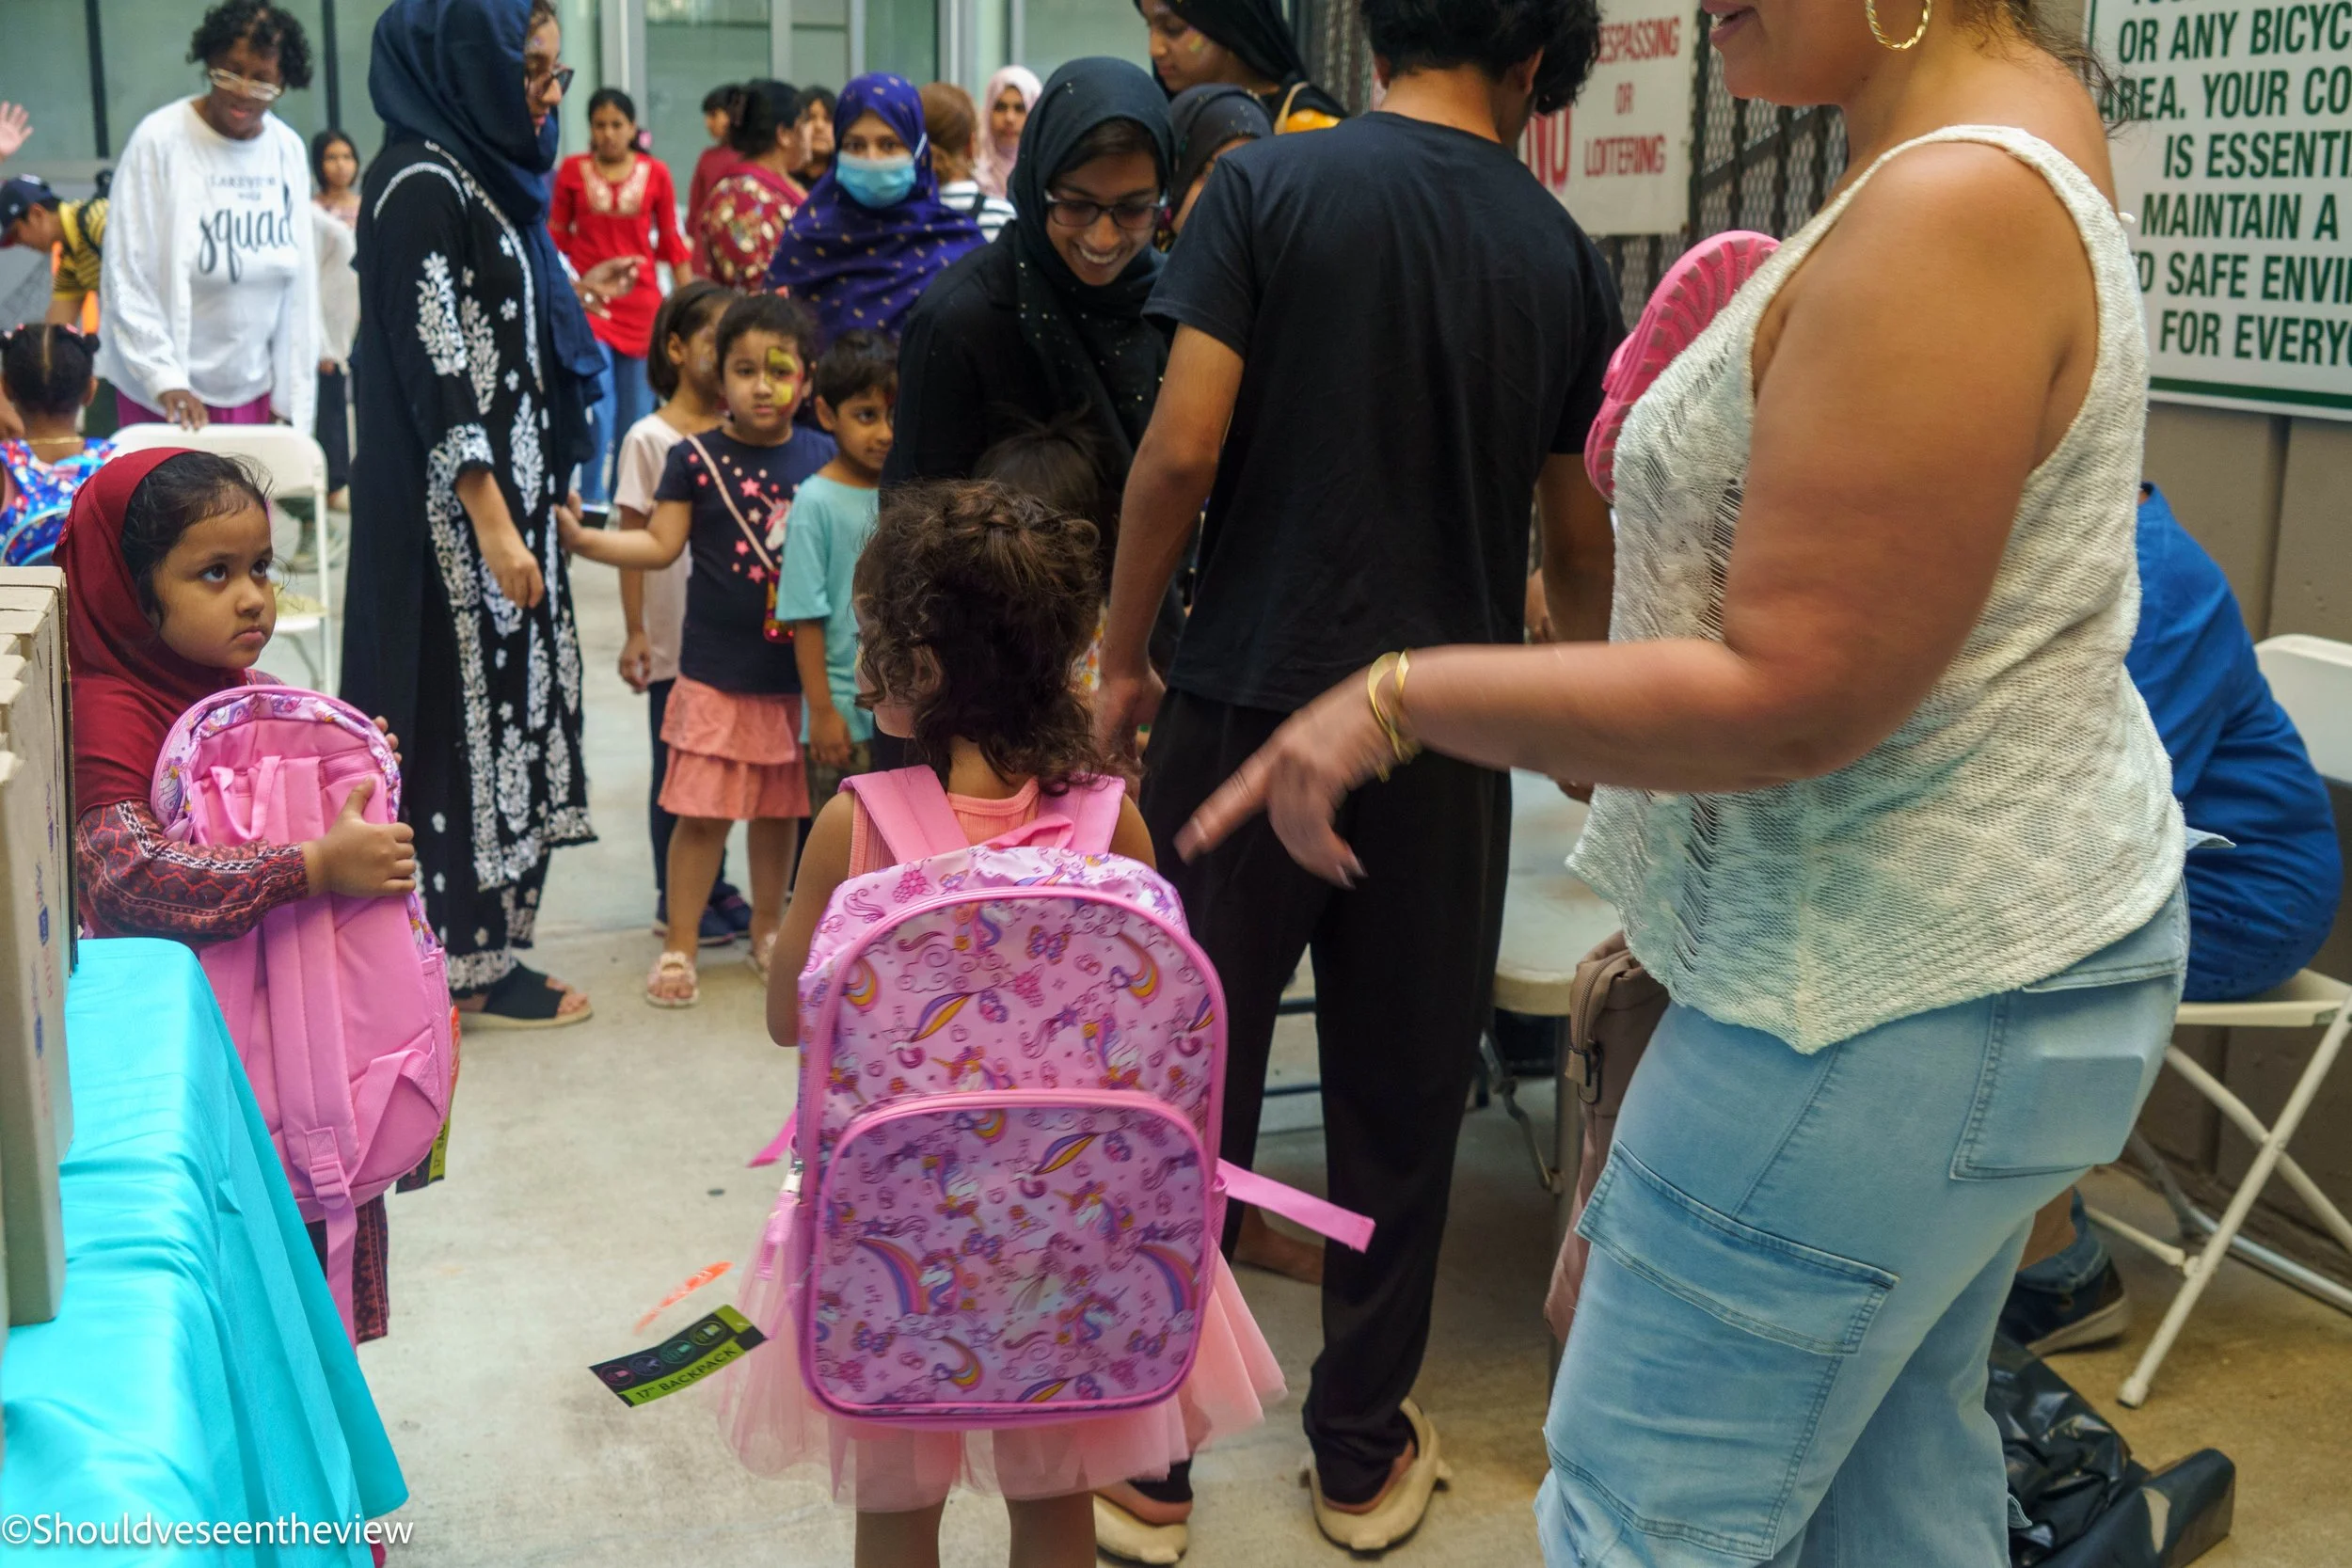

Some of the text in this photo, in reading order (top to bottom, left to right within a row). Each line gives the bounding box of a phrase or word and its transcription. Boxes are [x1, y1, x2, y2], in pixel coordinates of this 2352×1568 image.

[1597, 15, 1680, 64] ESPASSING
[2119, 1, 2352, 63] OR ANY BICYC
[1615, 81, 1634, 115] OR
[2099, 65, 2352, 120] AREA. YOUR CO
[1526, 103, 1573, 194] NO
[1584, 134, 1665, 177] LOITERING
[2164, 134, 2195, 179] IS
[198, 182, 298, 285] squad
[2140, 193, 2339, 242] MAINTAIN A
[2131, 250, 2154, 293] D
[2167, 251, 2249, 299] SAFE
[2159, 309, 2352, 368] FOR EVERY
[660, 1348, 739, 1391] BACKPACK
